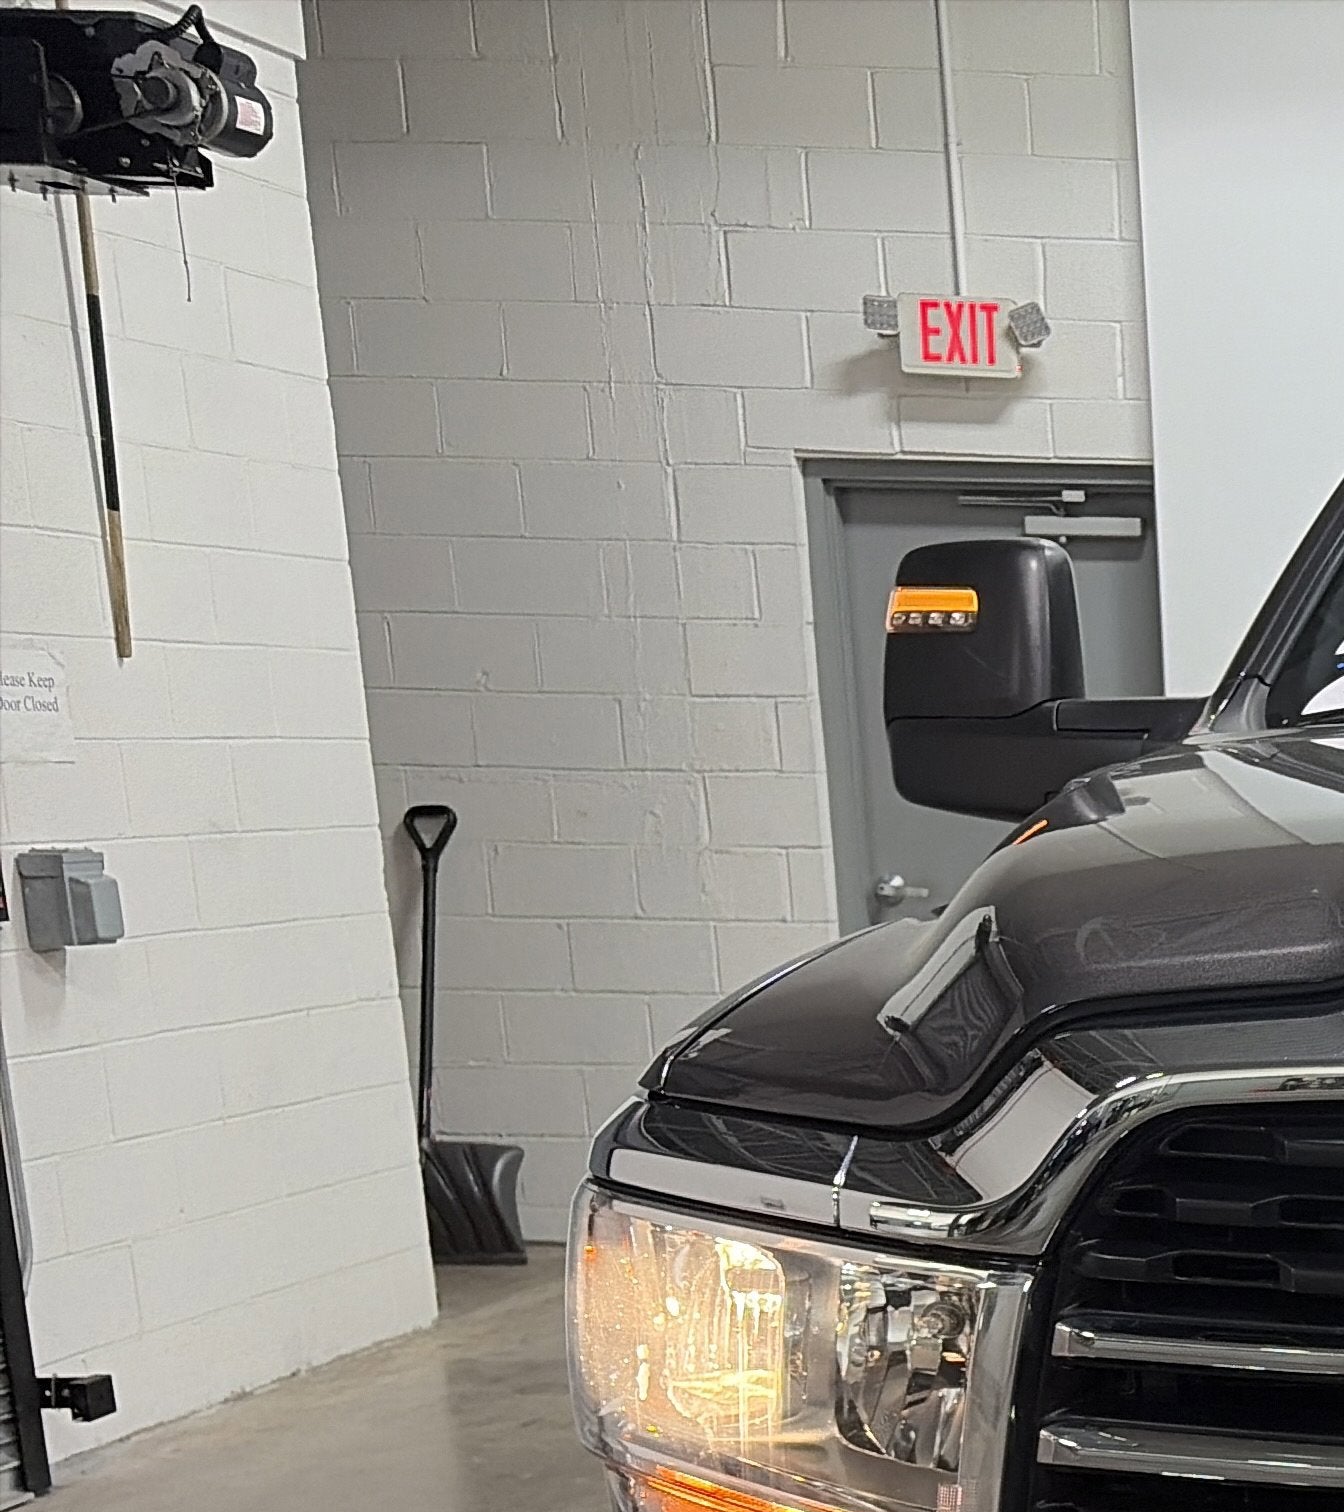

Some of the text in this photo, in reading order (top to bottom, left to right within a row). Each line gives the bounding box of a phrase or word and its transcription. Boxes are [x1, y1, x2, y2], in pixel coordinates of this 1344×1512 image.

[918, 298, 1000, 367] EXIT
[0, 671, 55, 693] lease Keep
[23, 695, 60, 713] Closed
